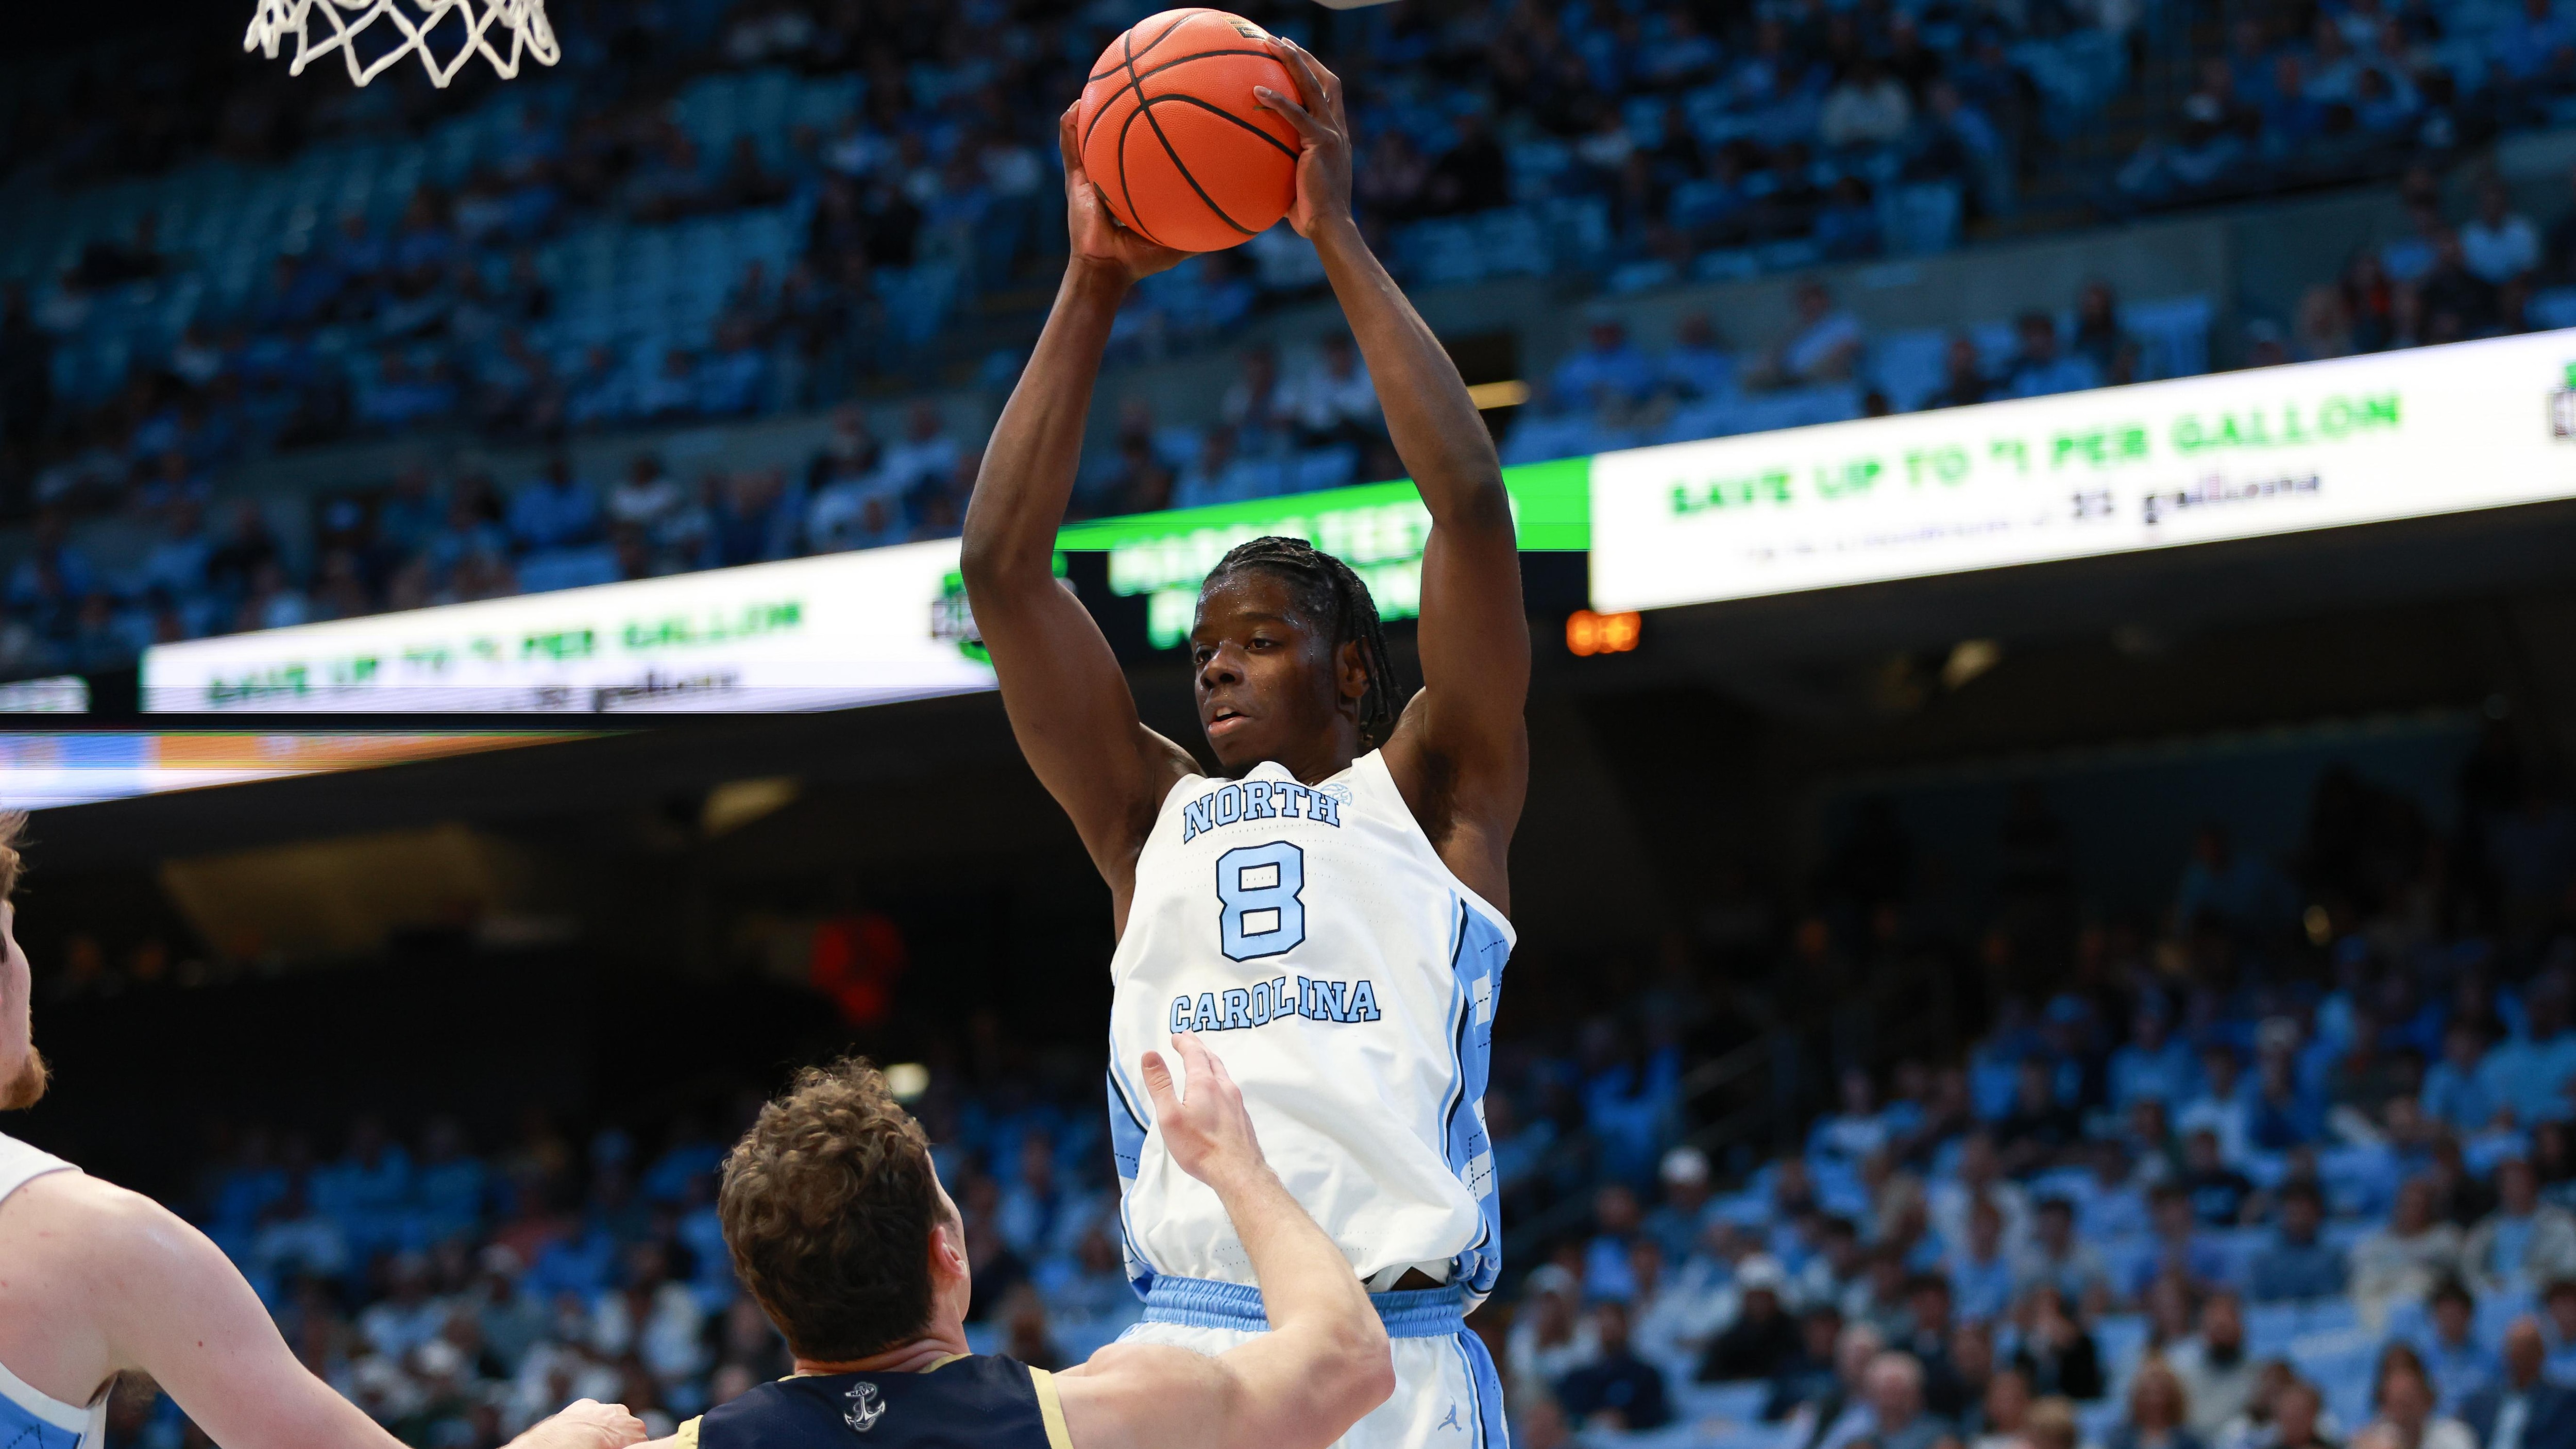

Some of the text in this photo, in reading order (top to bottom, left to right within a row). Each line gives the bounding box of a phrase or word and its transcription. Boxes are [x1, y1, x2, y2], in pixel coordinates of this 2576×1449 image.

[2049, 423, 2150, 468] PER
[2170, 393, 2402, 454] GALLON
[1183, 781, 1340, 845] NORTH
[1216, 840, 1306, 963] 8
[1170, 975, 1381, 1034] CAROLINA
[850, 1387, 872, 1396] NAVY
